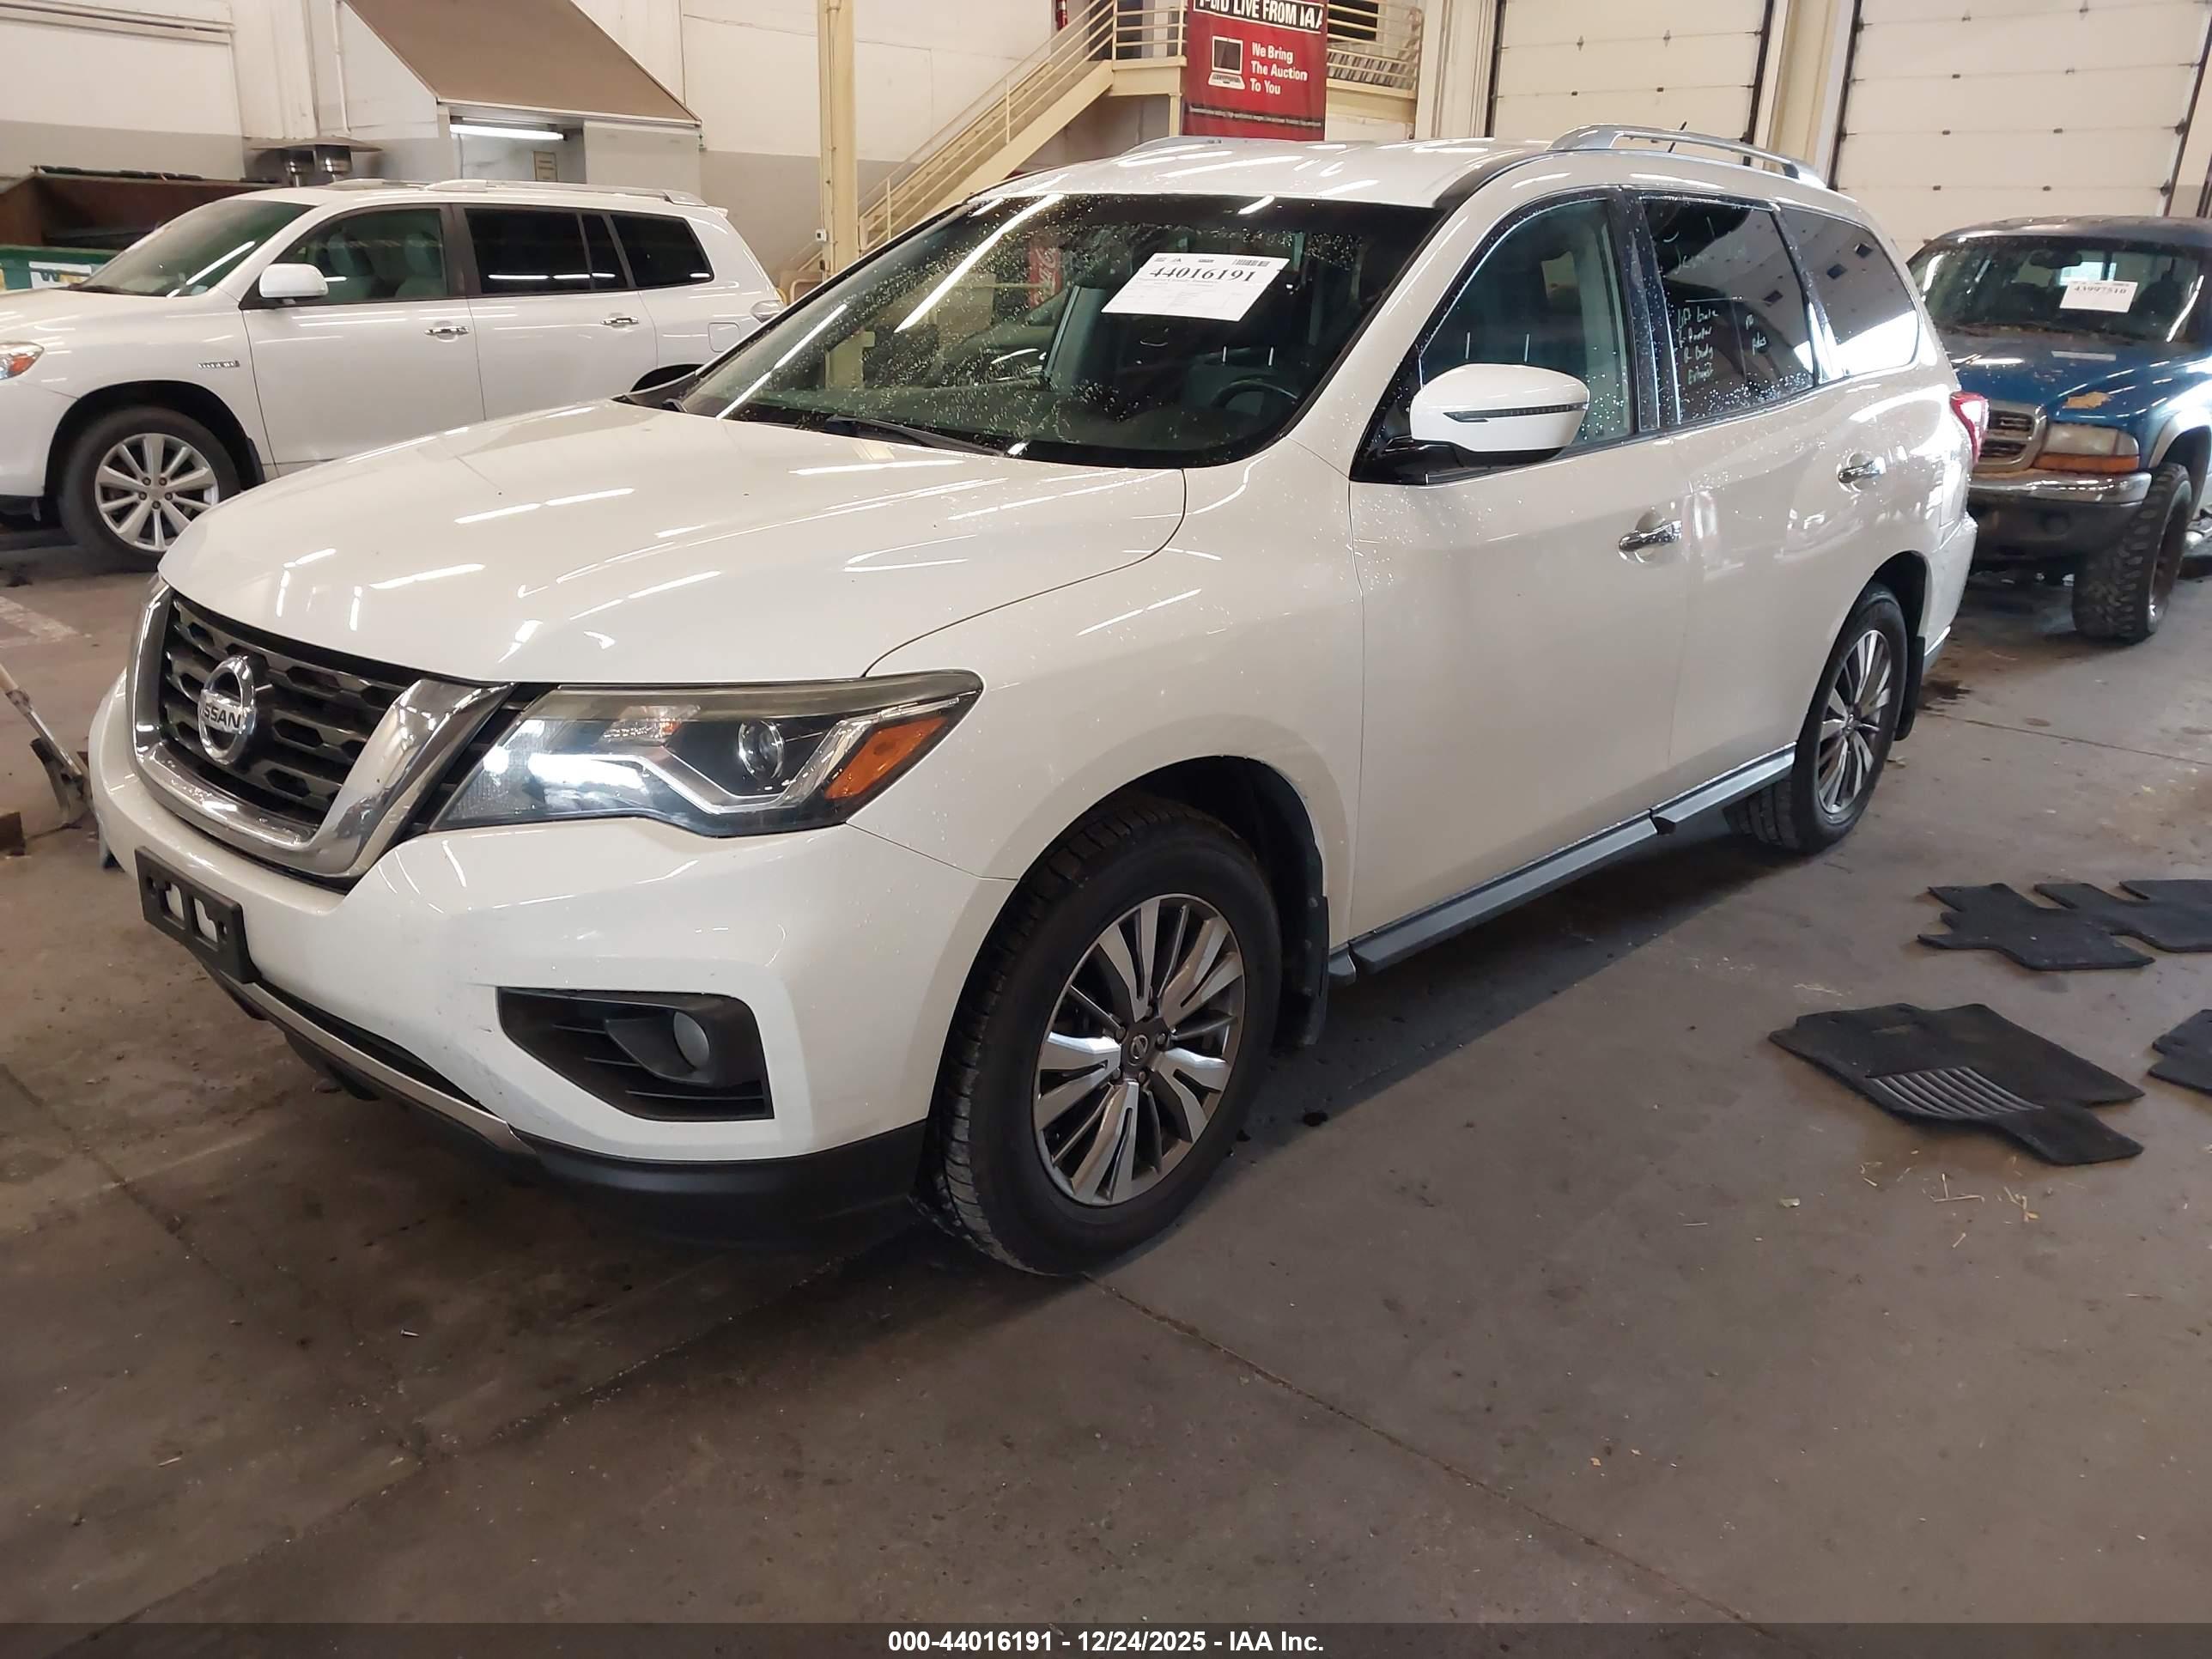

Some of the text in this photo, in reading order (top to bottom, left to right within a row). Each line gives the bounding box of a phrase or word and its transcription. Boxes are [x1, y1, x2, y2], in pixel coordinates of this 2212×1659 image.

[1233, 0, 1260, 18] LIVE
[1262, 0, 1297, 26] FROM
[1252, 42, 1294, 64] We Bring
[1251, 60, 1308, 81] The Auction
[1249, 78, 1281, 94] To You
[1150, 267, 1255, 282] 44016191
